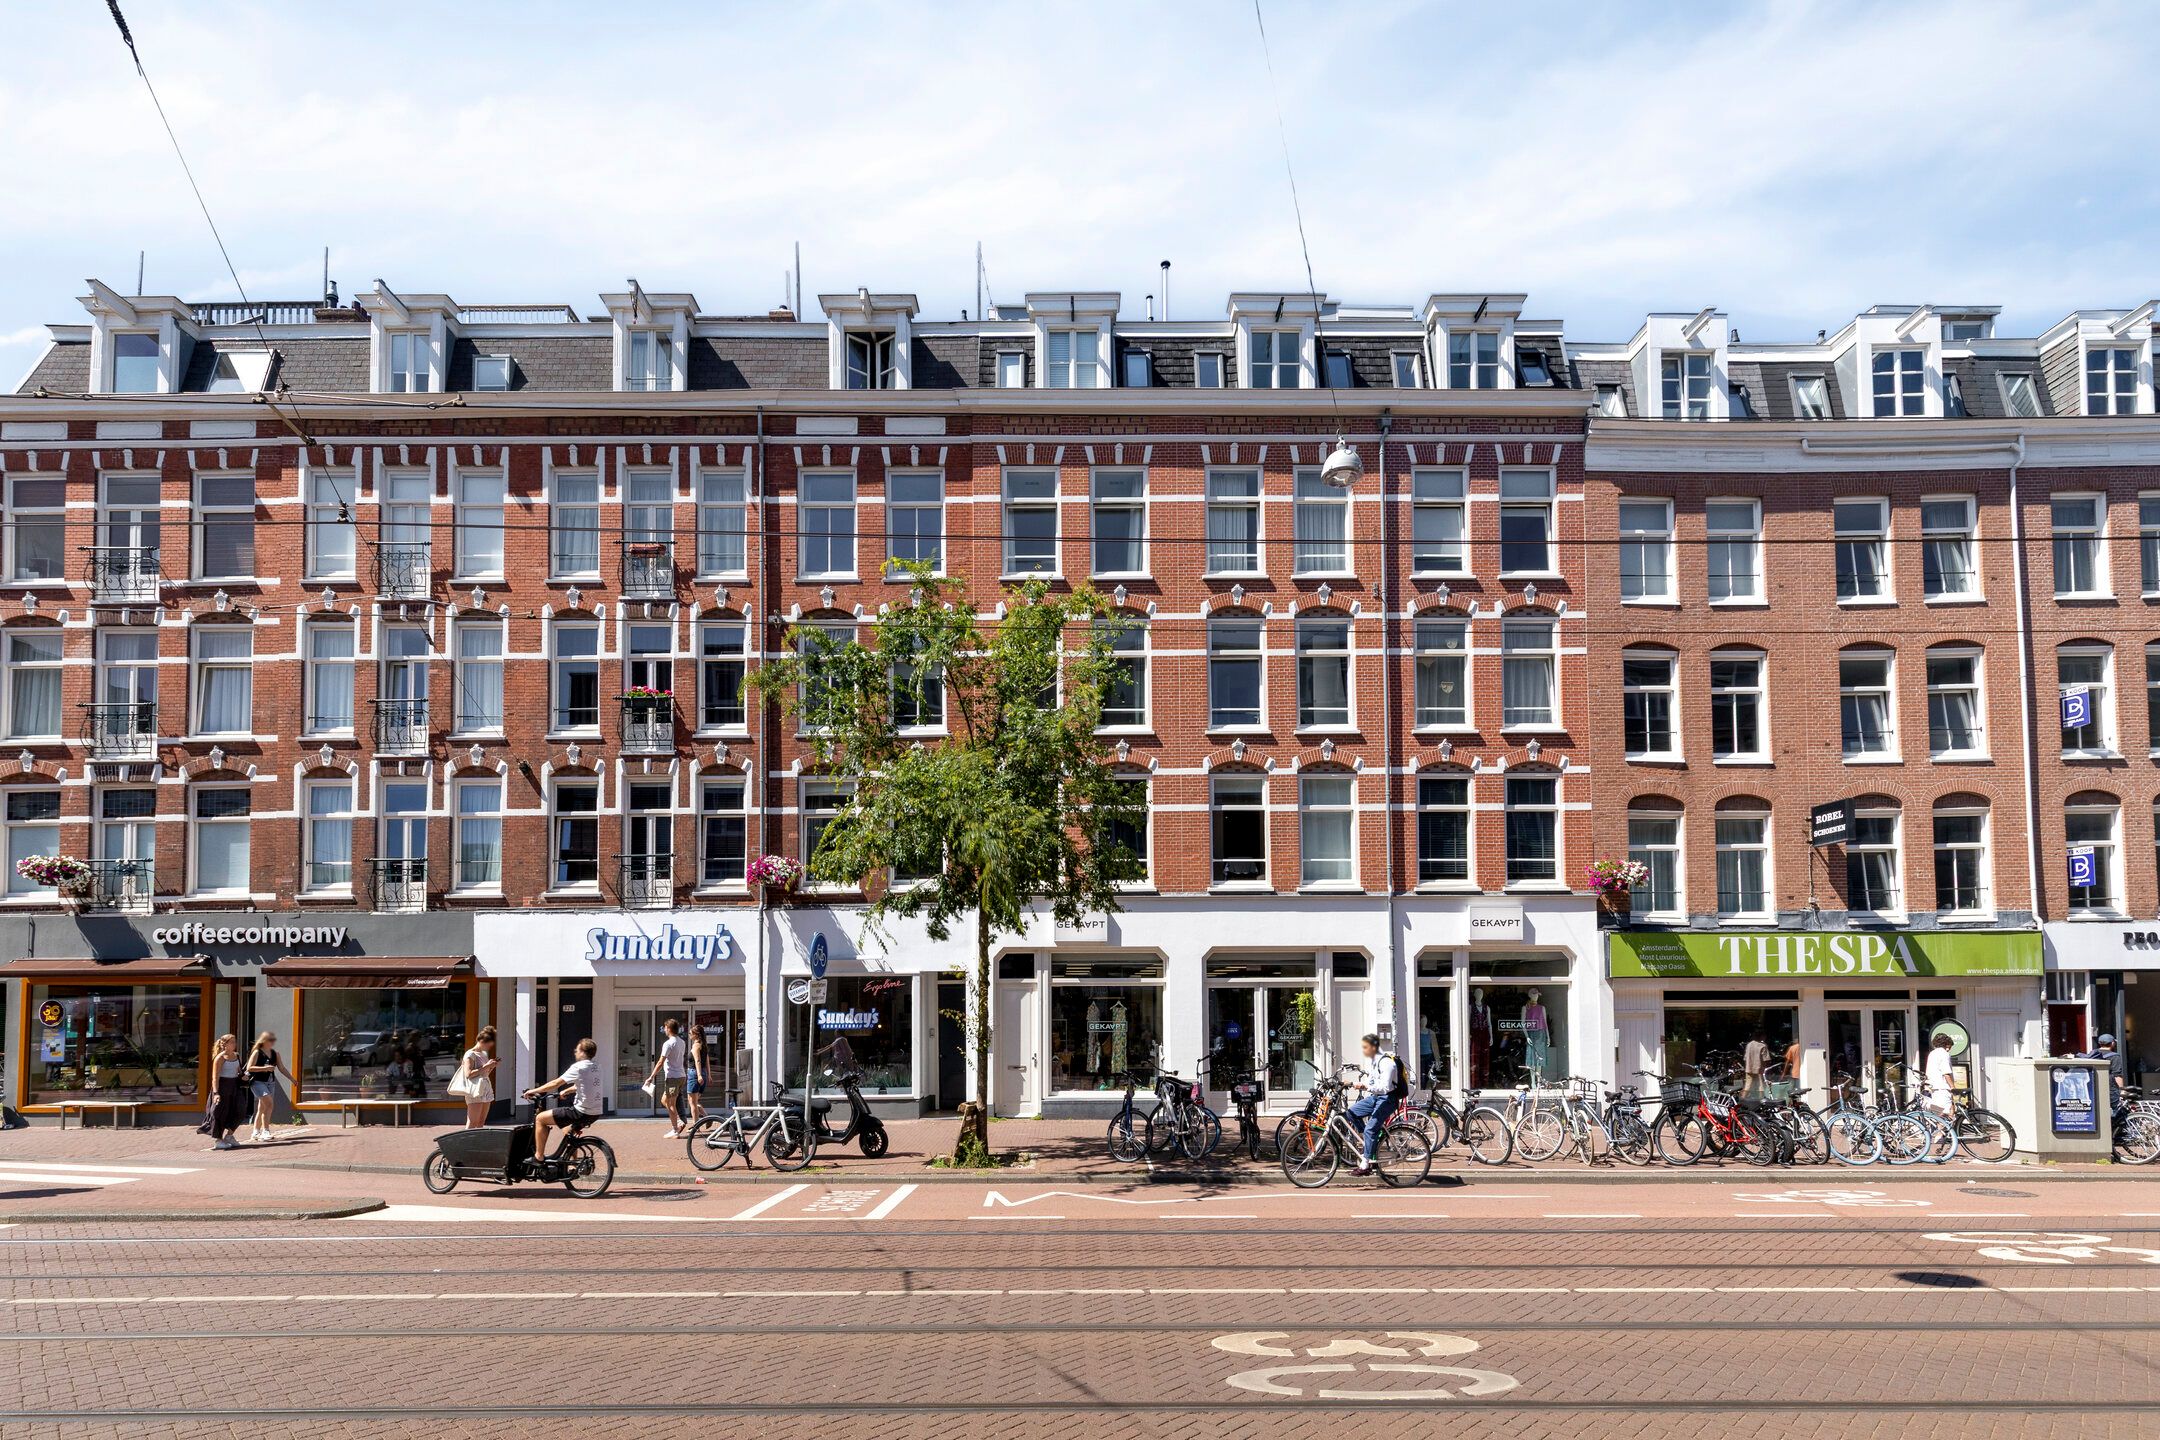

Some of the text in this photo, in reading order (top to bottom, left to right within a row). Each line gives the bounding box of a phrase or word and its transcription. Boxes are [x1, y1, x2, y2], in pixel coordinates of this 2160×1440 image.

[2069, 686, 2087, 695] KOOP
[1815, 810, 1844, 824] ROBEL
[1813, 823, 1846, 837] SCHOENEN
[152, 922, 346, 948] coffeecompany
[585, 924, 731, 970] Sunday's
[1719, 935, 1920, 974] THE SPA
[1966, 968, 2040, 976] www.thespa.amsterdam
[817, 1008, 880, 1028] Sunday's
